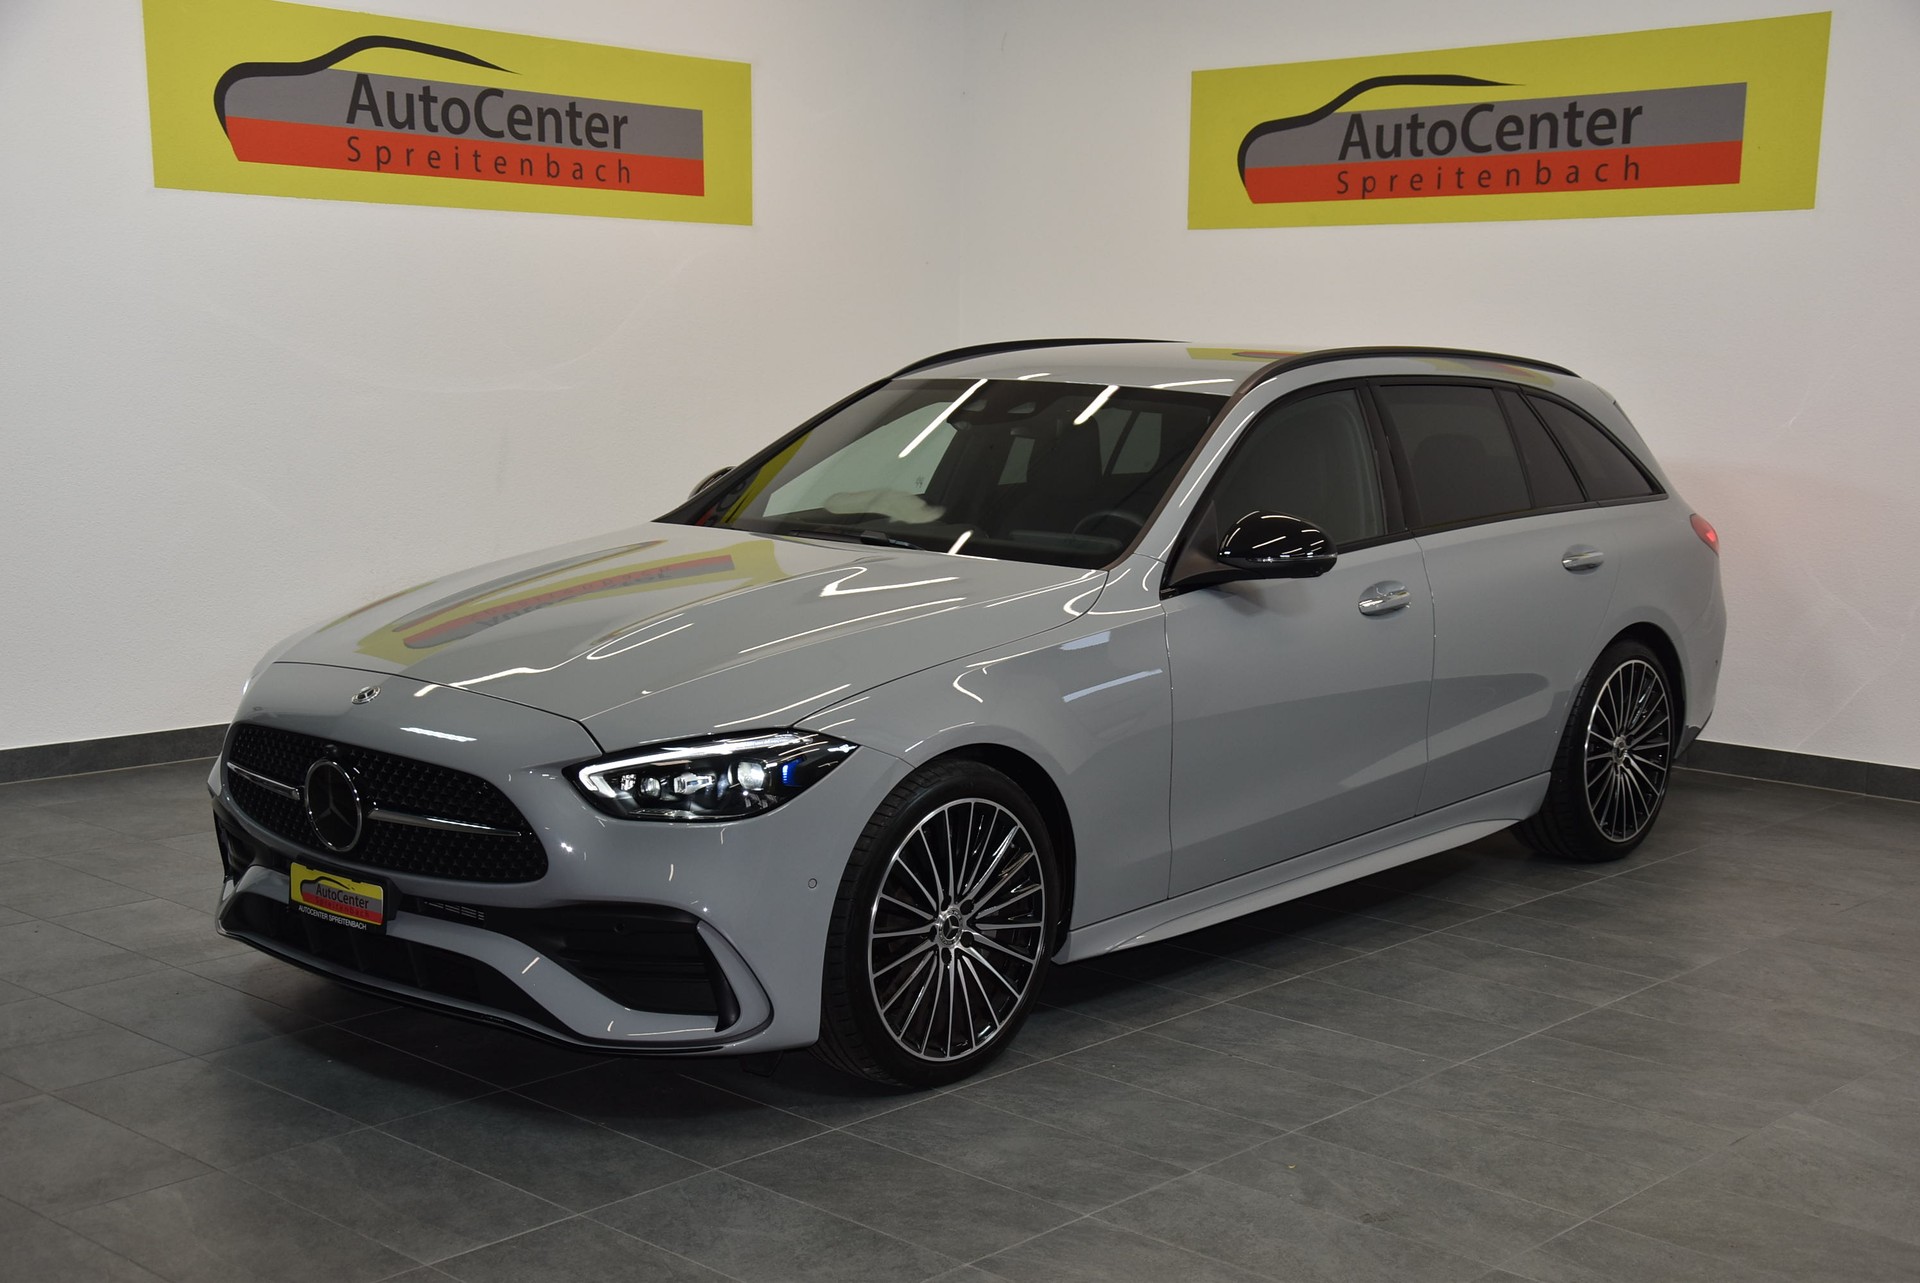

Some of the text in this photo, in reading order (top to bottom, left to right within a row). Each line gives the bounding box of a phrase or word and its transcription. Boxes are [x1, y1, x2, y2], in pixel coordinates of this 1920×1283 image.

[346, 73, 628, 150] AutoCenter
[1337, 101, 1644, 161] AutoCenter
[346, 136, 632, 184] Spreitenbach
[1336, 154, 1640, 200] Spreitenbach
[298, 905, 367, 930] AUTOCENTER SPREITENBACH
[316, 884, 369, 909] AutoCenter
